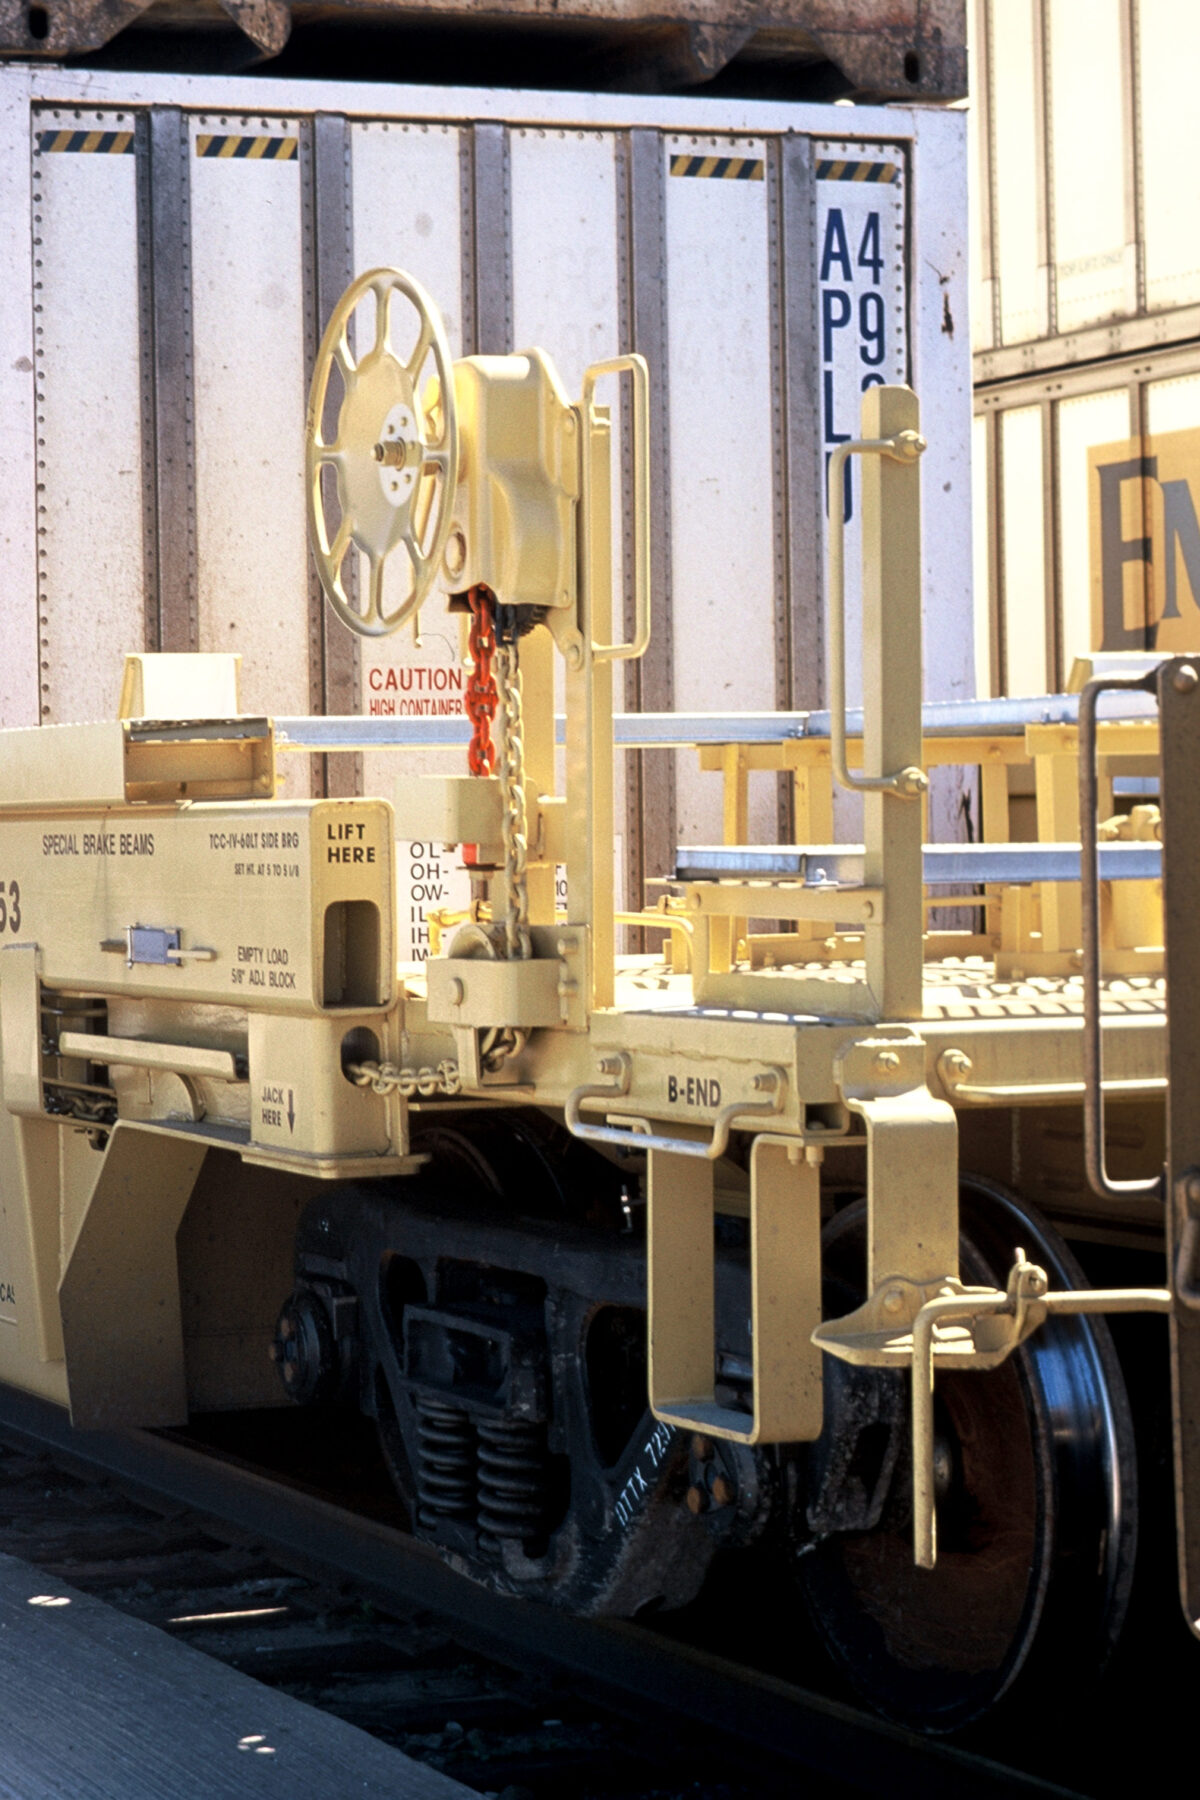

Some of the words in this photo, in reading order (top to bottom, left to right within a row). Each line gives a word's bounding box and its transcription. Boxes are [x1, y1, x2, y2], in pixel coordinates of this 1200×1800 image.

[858, 212, 886, 392] 49
[369, 668, 462, 691] CAUTION
[370, 698, 395, 716] HIGH
[400, 698, 462, 716] CONTAINER
[261, 832, 279, 848] SIDE
[281, 832, 299, 848] BRG
[328, 824, 365, 840] LIFT
[43, 834, 79, 856] SPECIAL
[83, 834, 116, 855] BRAKE
[120, 833, 154, 856] BEAMS
[328, 847, 375, 863] HERE
[273, 864, 281, 876] TO
[238, 946, 263, 963] EMPTY
[267, 948, 288, 965] LOAD
[269, 971, 296, 989] BLOCK
[262, 1086, 284, 1105] JACK
[668, 1075, 721, 1107] B-END
[262, 1108, 281, 1127] HERE
[615, 1466, 648, 1527] DTTX
